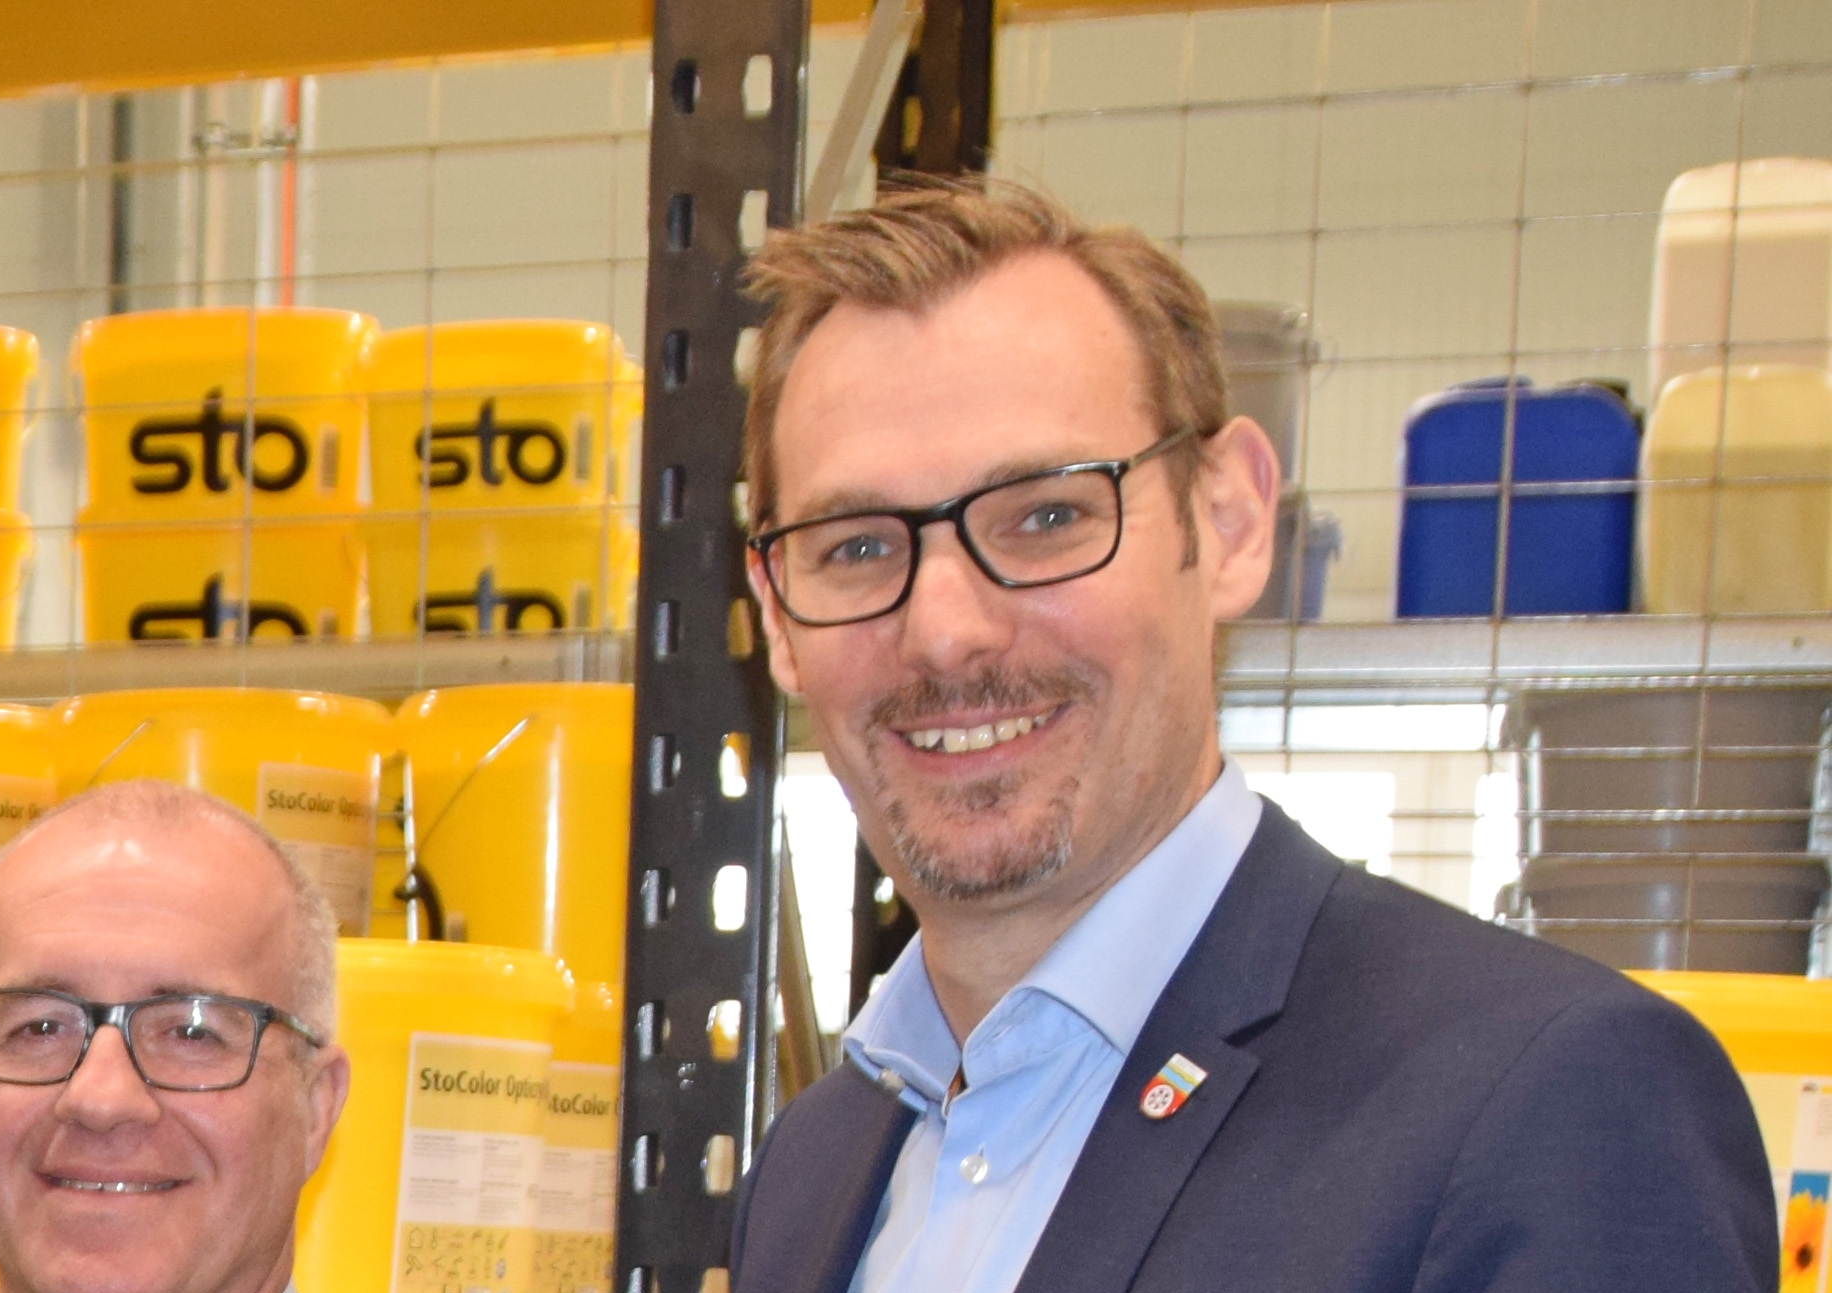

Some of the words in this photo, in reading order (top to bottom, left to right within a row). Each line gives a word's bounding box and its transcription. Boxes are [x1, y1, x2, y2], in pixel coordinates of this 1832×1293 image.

[130, 386, 310, 495] sto
[416, 397, 567, 488] sto
[419, 1066, 501, 1097] StoColor
[548, 1092, 611, 1117] toColor
